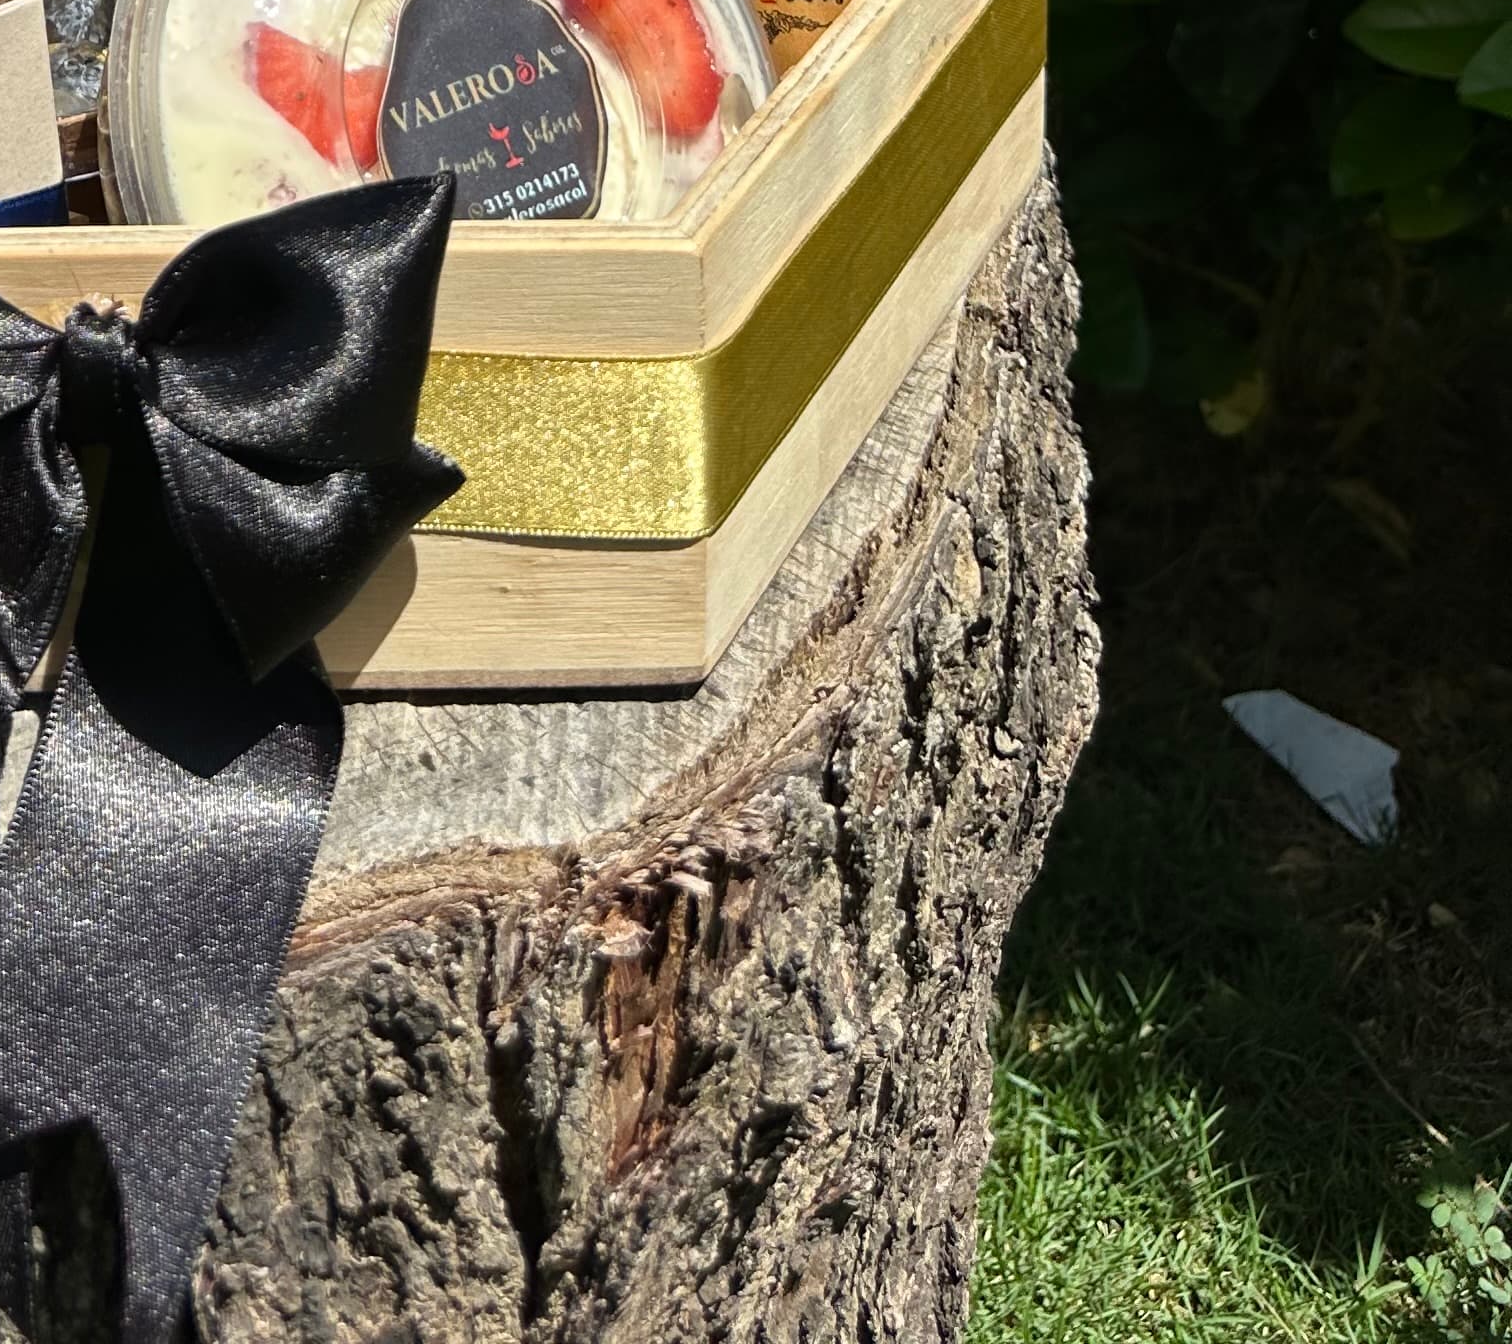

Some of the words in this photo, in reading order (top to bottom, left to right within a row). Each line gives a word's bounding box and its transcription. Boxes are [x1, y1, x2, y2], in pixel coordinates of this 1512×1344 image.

[389, 49, 560, 133] VALEROSA
[483, 190, 514, 214] 315
[515, 162, 580, 201] 0214173
[504, 178, 588, 221] lerosacol
